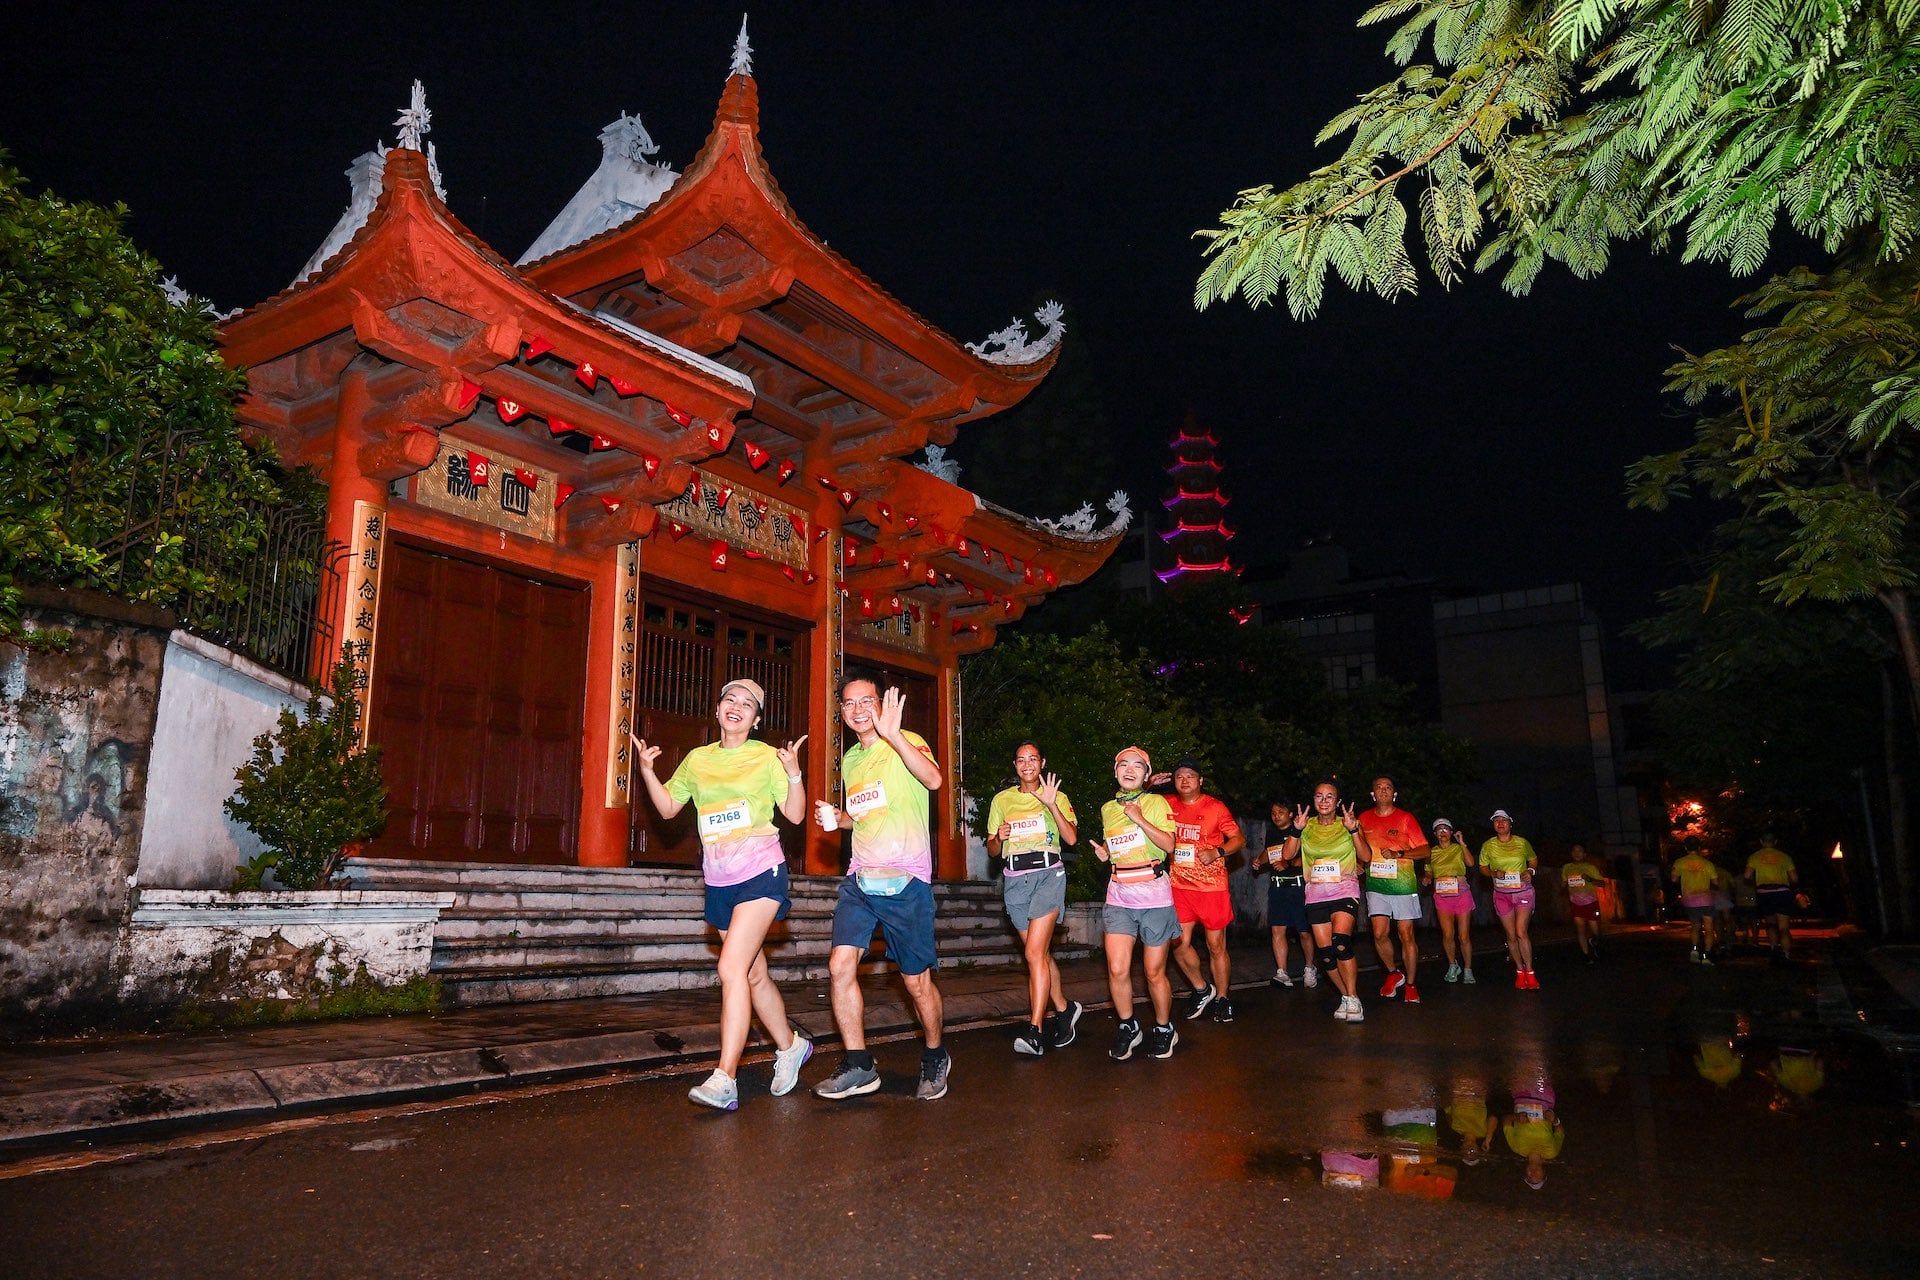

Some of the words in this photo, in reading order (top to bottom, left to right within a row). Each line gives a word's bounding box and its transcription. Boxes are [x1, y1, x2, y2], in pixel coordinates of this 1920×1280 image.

[849, 790, 879, 807] M2020
[709, 810, 741, 825] F2168
[1012, 820, 1038, 829] F1030
